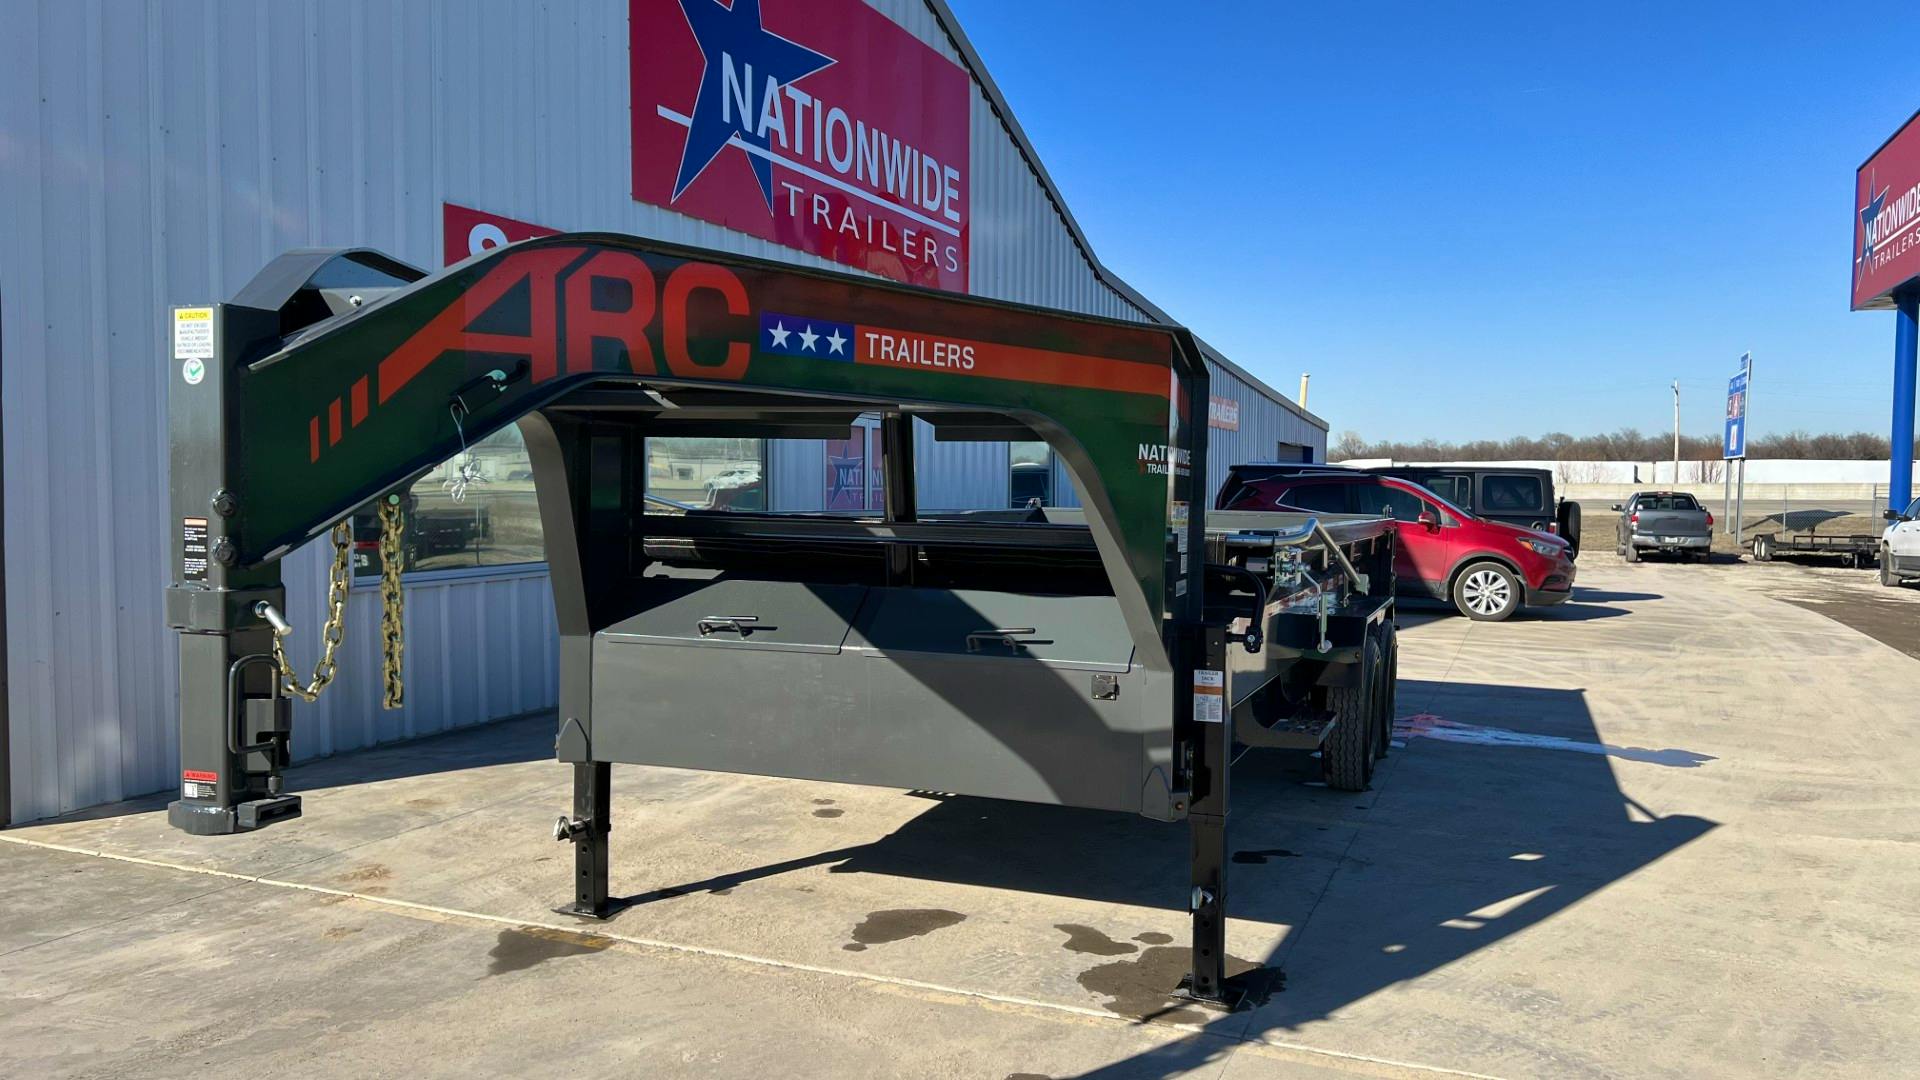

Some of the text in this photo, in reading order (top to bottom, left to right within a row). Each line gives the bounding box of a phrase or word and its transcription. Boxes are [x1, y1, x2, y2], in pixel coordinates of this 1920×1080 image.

[722, 51, 960, 223] NATIONWIDE
[781, 181, 958, 272] TRAILERS
[378, 247, 751, 406] ARC
[864, 332, 975, 370] TRAILERS
